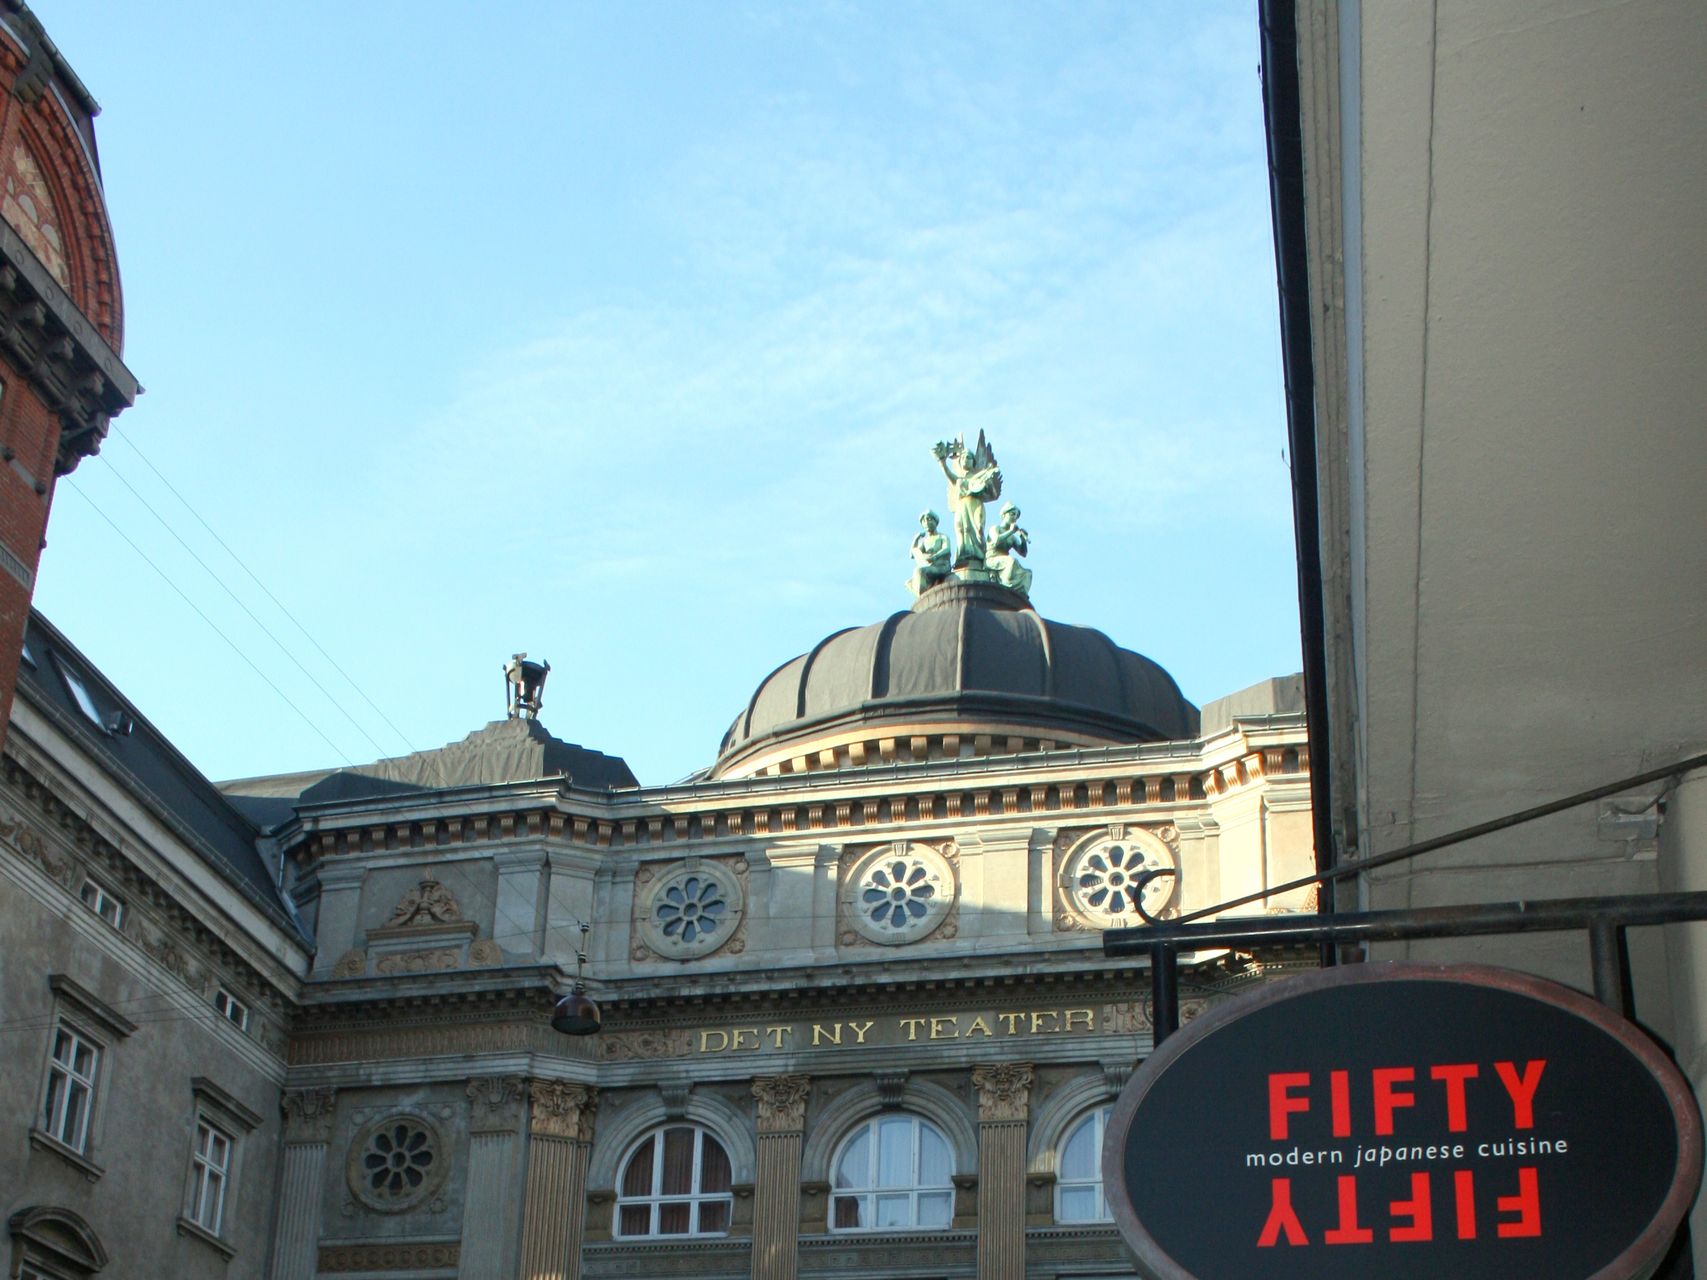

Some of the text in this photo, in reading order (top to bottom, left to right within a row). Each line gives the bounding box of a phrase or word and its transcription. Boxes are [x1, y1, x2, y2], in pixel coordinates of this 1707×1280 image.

[700, 1008, 1096, 1053] DET NY TEATER
[1268, 1059, 1547, 1141] FIFTY
[1245, 1136, 1569, 1168] modern japanese cuisine
[1256, 1166, 1542, 1248] FIFTY
